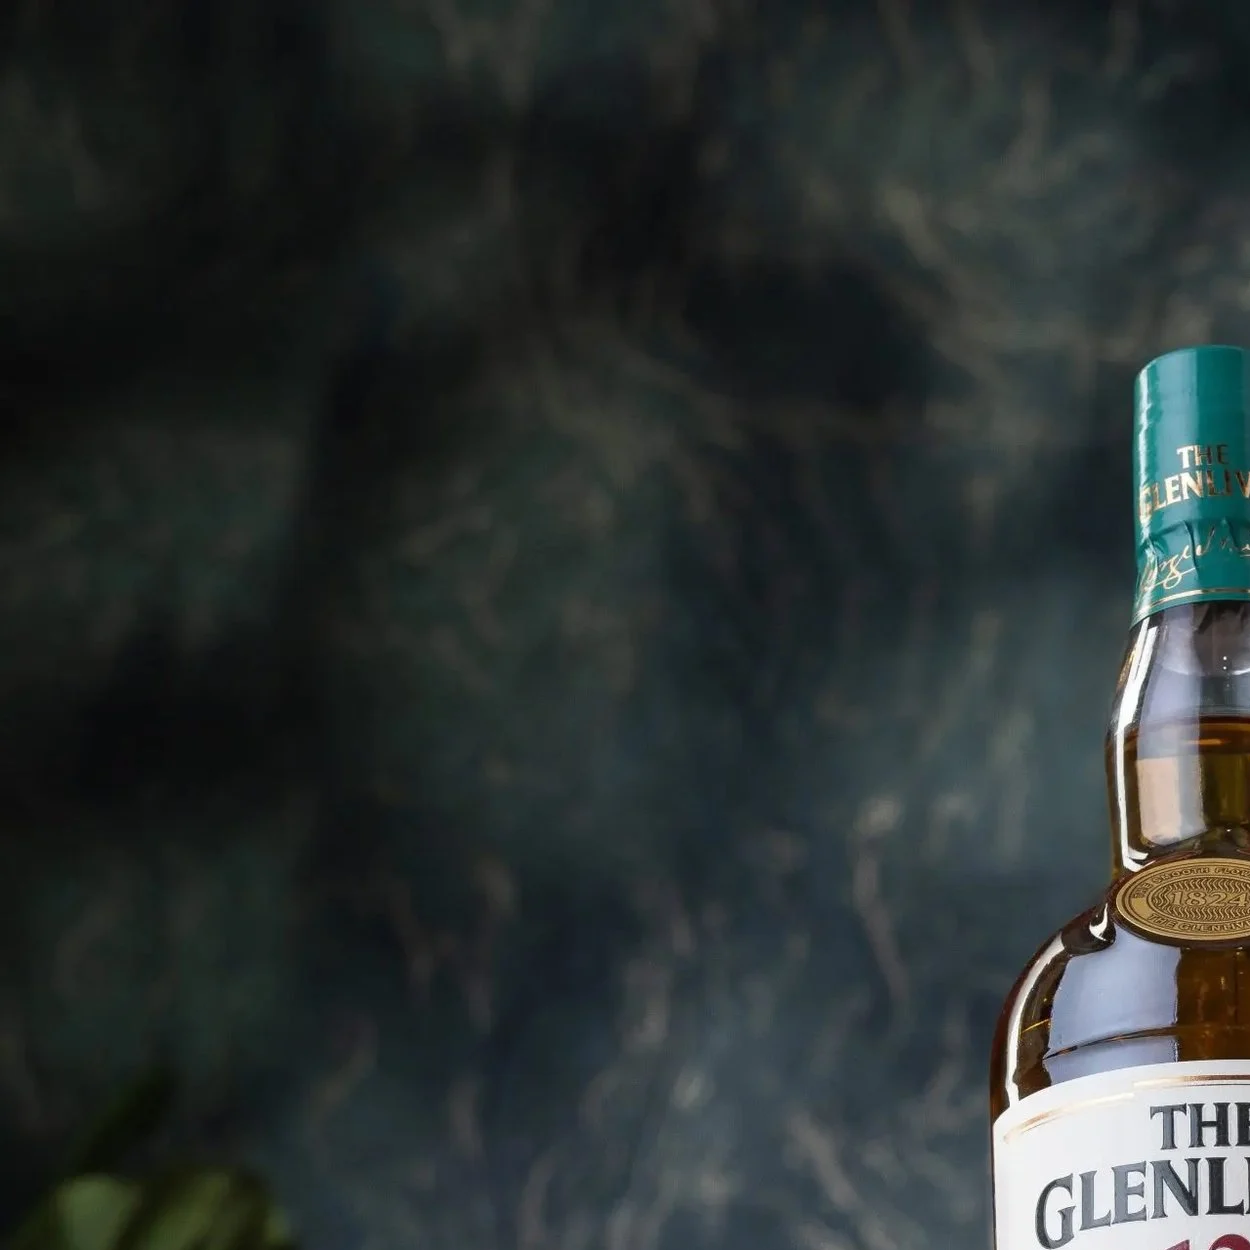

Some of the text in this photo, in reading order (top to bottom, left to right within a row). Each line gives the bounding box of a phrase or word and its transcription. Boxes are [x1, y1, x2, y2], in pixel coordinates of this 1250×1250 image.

[1176, 444, 1229, 469] THE
[1169, 890, 1249, 907] 1824
[1147, 913, 1178, 929] THE
